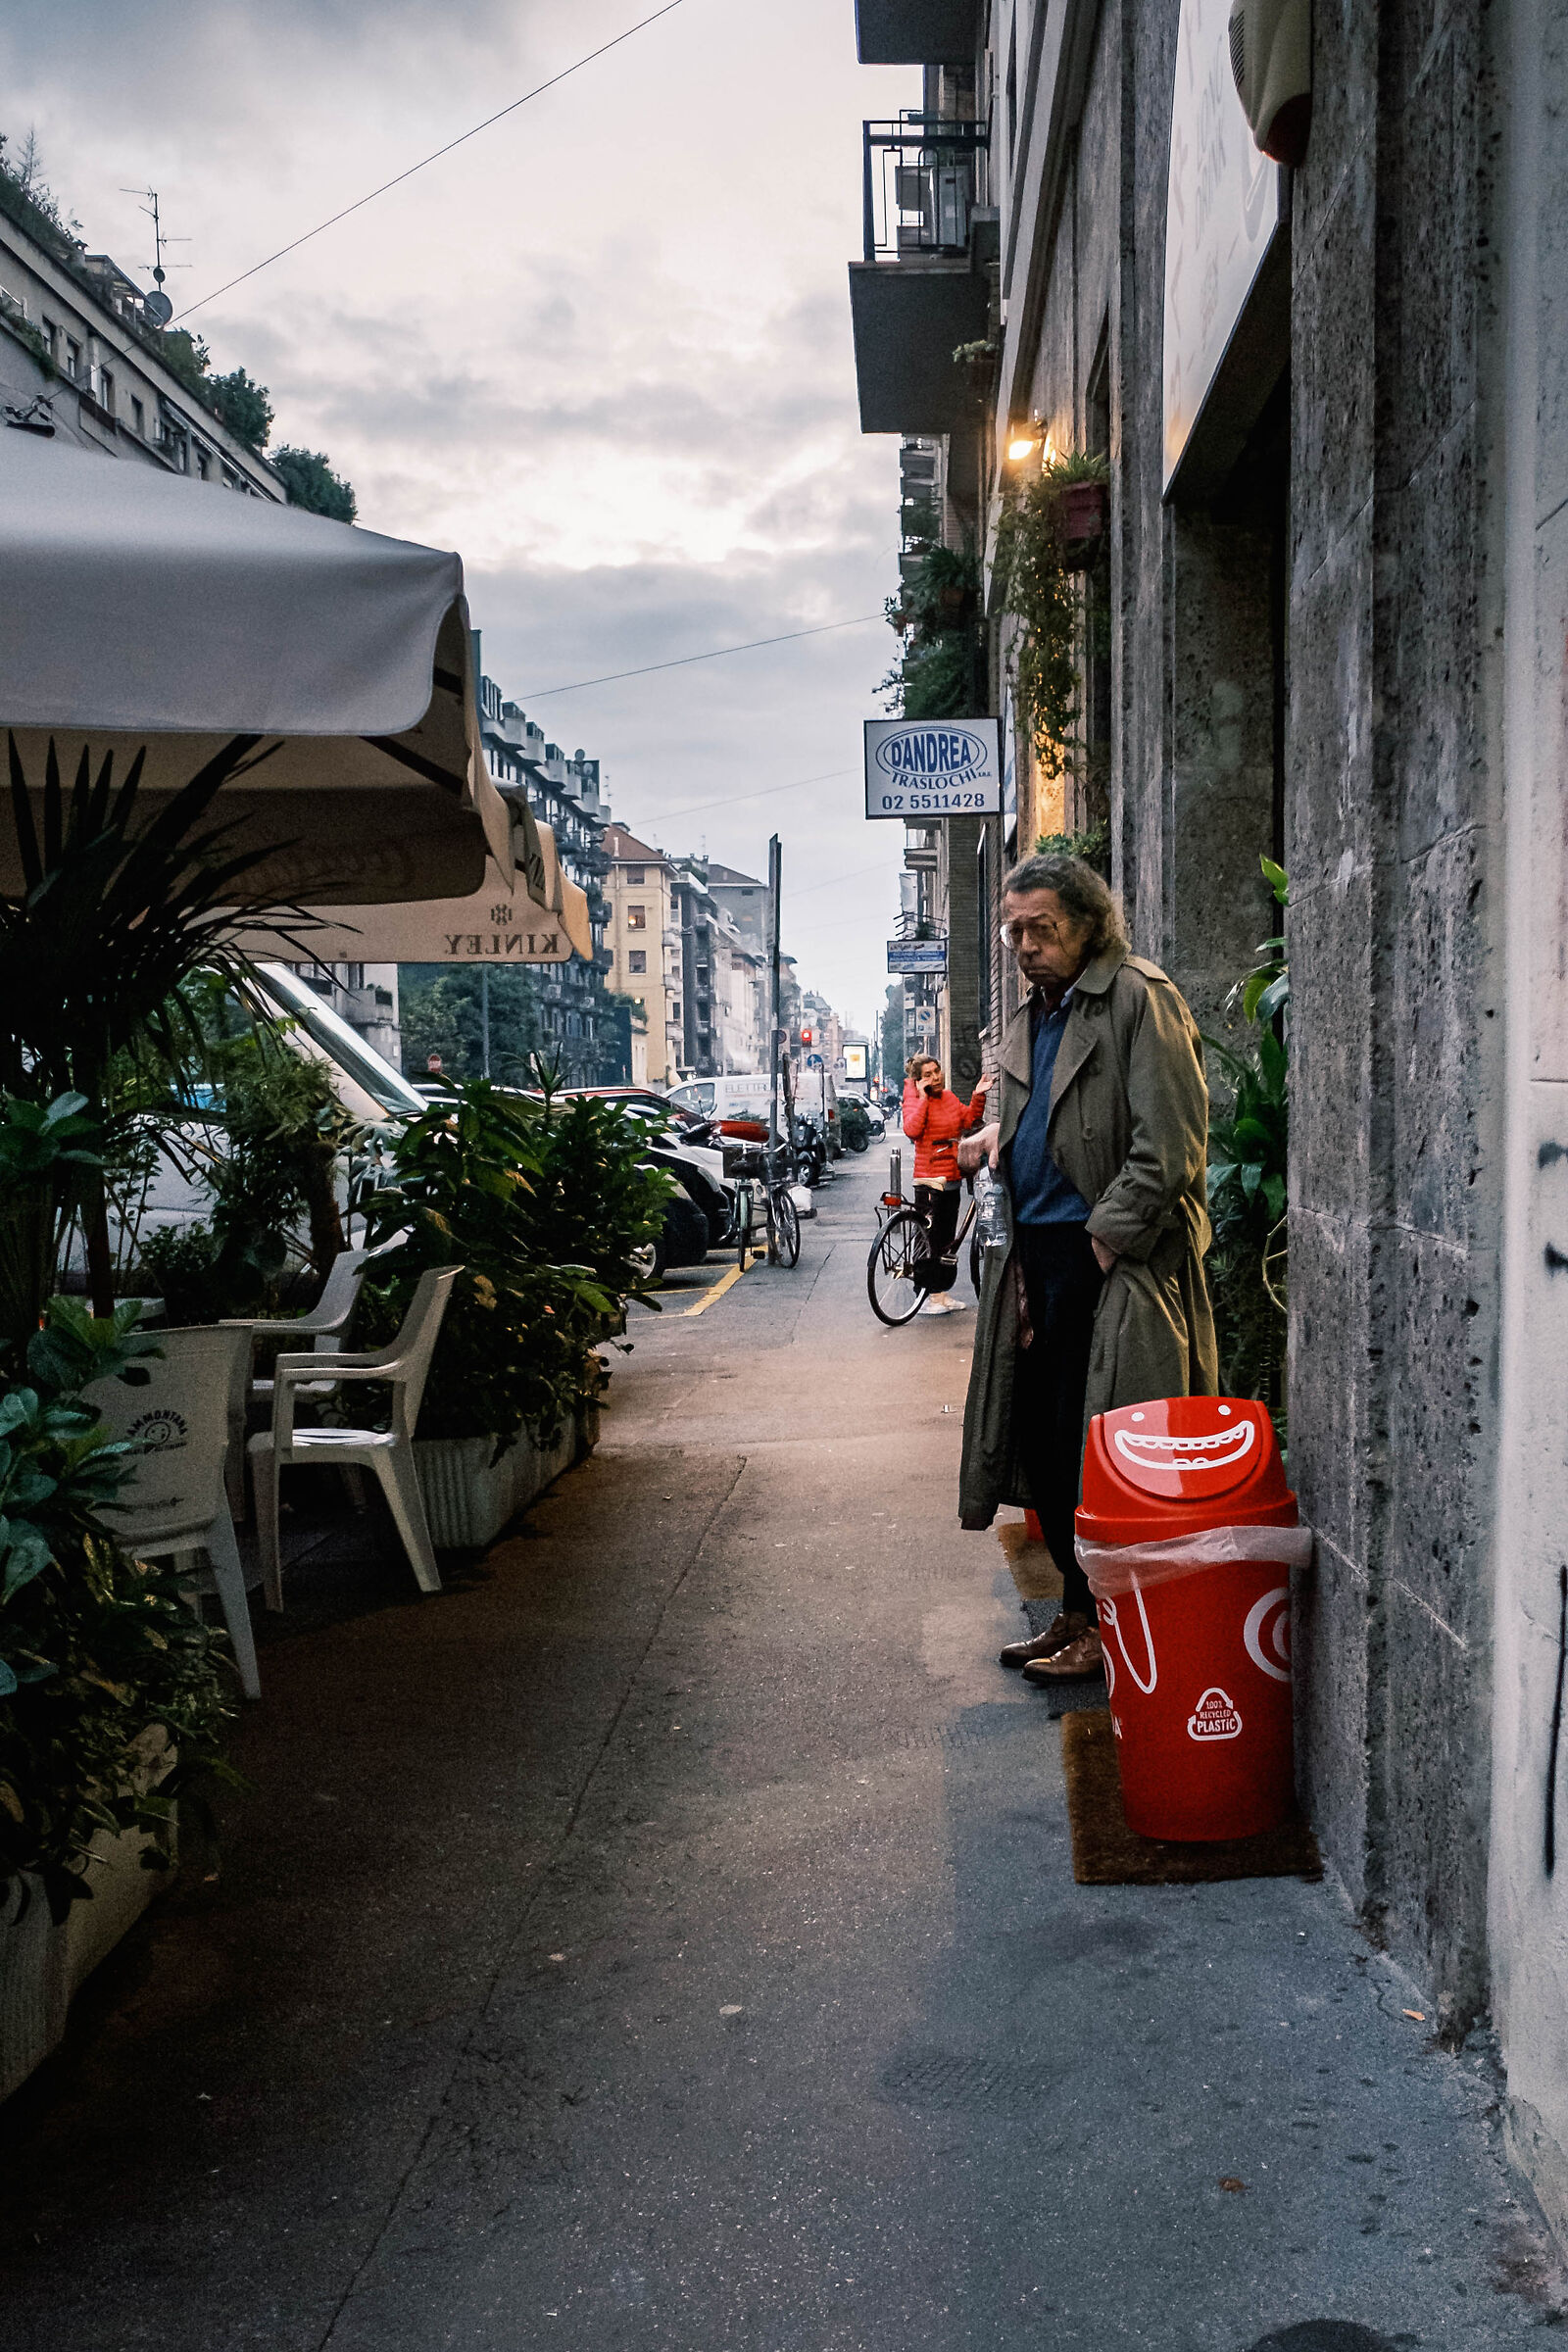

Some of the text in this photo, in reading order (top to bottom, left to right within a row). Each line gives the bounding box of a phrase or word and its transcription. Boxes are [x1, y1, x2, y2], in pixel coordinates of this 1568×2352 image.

[891, 733, 971, 772] D'ANDREA
[892, 767, 977, 789] TRASLOCHI
[882, 793, 985, 809] 02 5511428
[122, 1409, 188, 1441] AMMONTANA
[1200, 1709, 1232, 1719] RECYCLED
[1206, 1700, 1223, 1709] 100%
